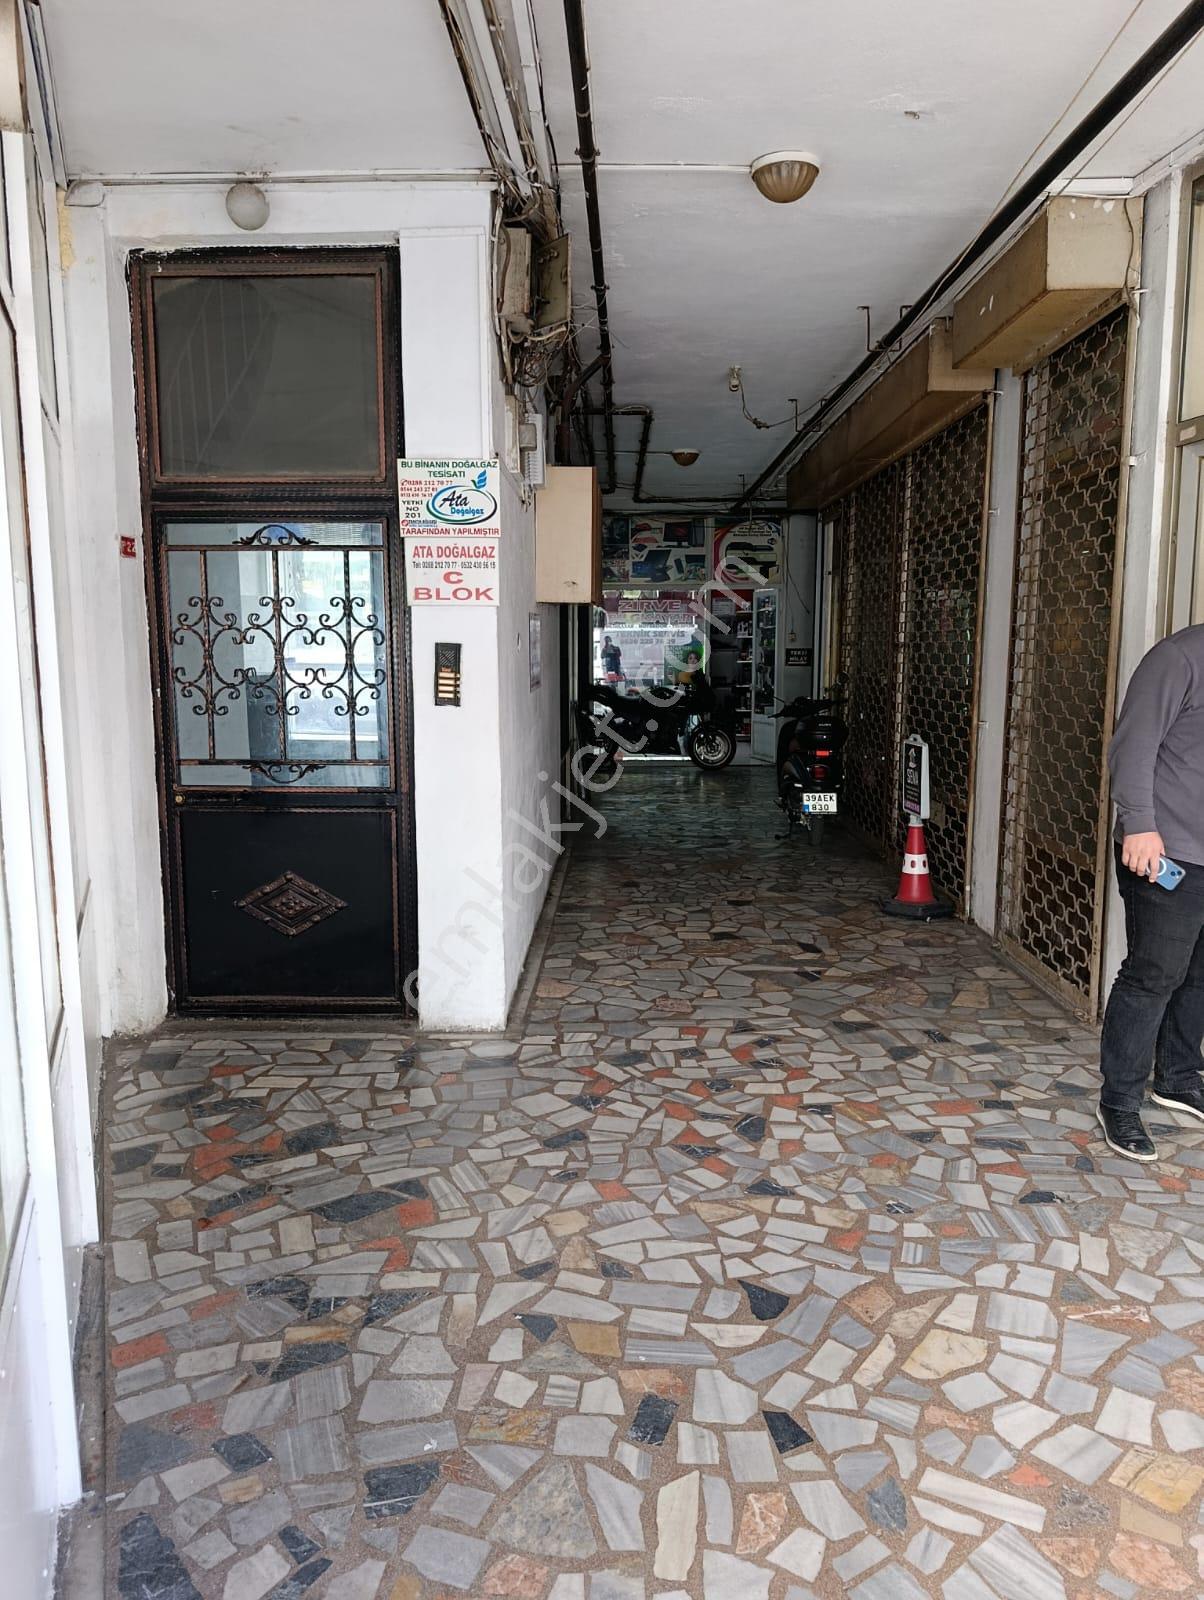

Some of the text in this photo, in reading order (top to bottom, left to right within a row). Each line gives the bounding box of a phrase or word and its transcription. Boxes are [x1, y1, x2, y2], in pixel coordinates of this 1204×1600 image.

[415, 460, 450, 468] BİNANIN
[452, 460, 498, 468] DOĞALGAZ
[439, 490, 470, 508] Ata
[451, 506, 484, 516] Doğalgaz
[452, 527, 500, 536] YAPILMIŞTIR
[412, 543, 496, 558] ATA DOĞALGAZ
[443, 571, 463, 584] C
[414, 587, 494, 601] BLOK
[811, 803, 829, 811] 830
